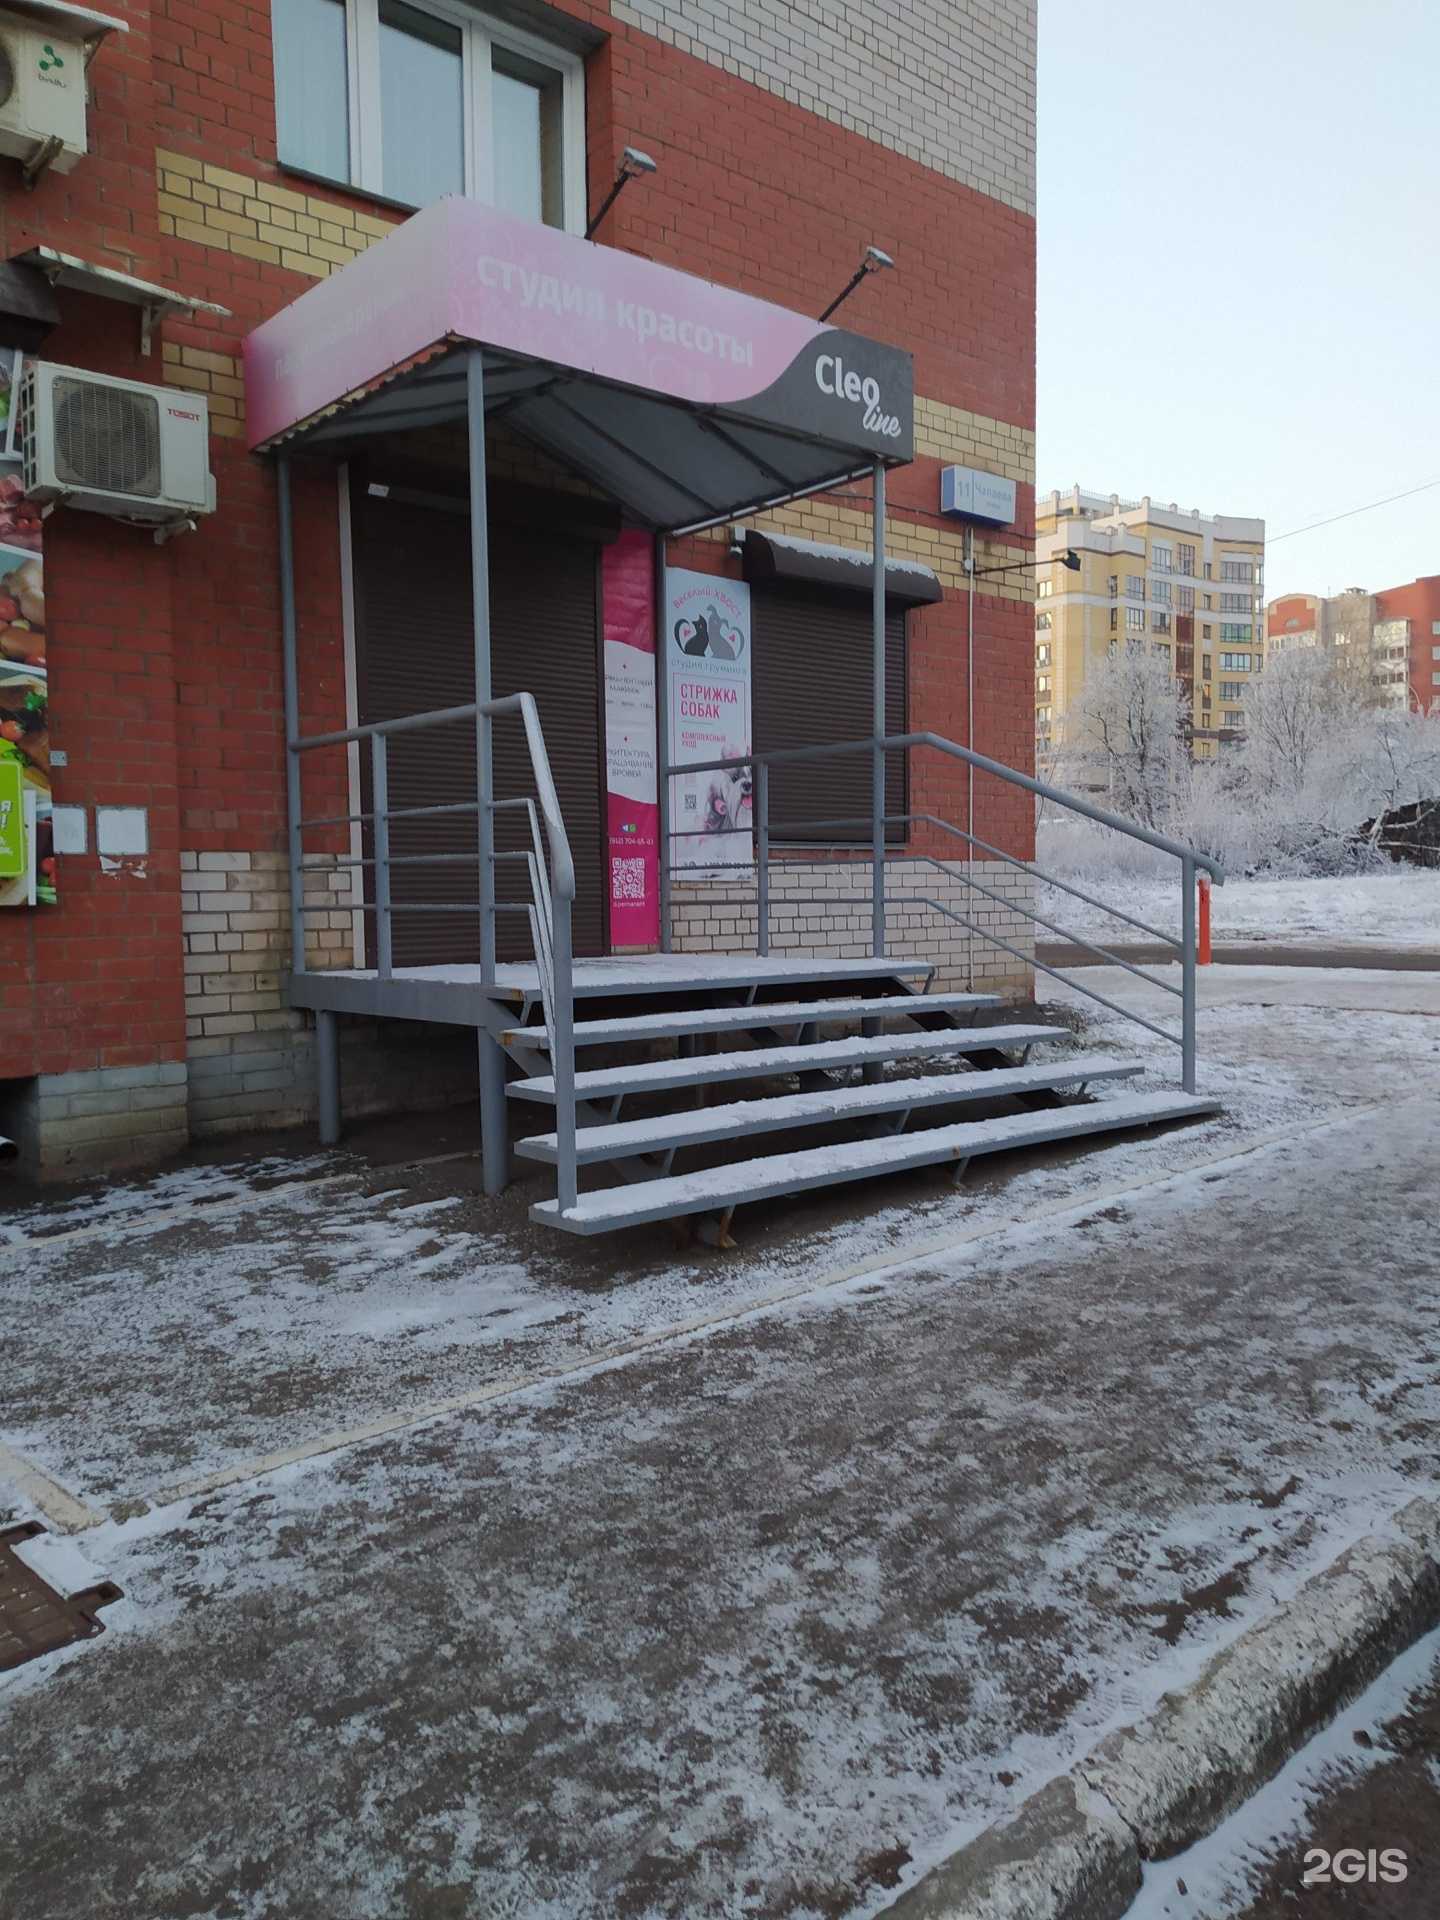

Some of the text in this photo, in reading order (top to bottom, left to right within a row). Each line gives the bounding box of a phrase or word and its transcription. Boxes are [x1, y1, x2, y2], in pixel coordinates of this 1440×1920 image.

[476, 254, 753, 366] студия красоты
[815, 354, 880, 407] Cleo
[862, 400, 902, 437] line
[680, 683, 738, 704] СТРИЖКА
[680, 700, 720, 719] СОБАК
